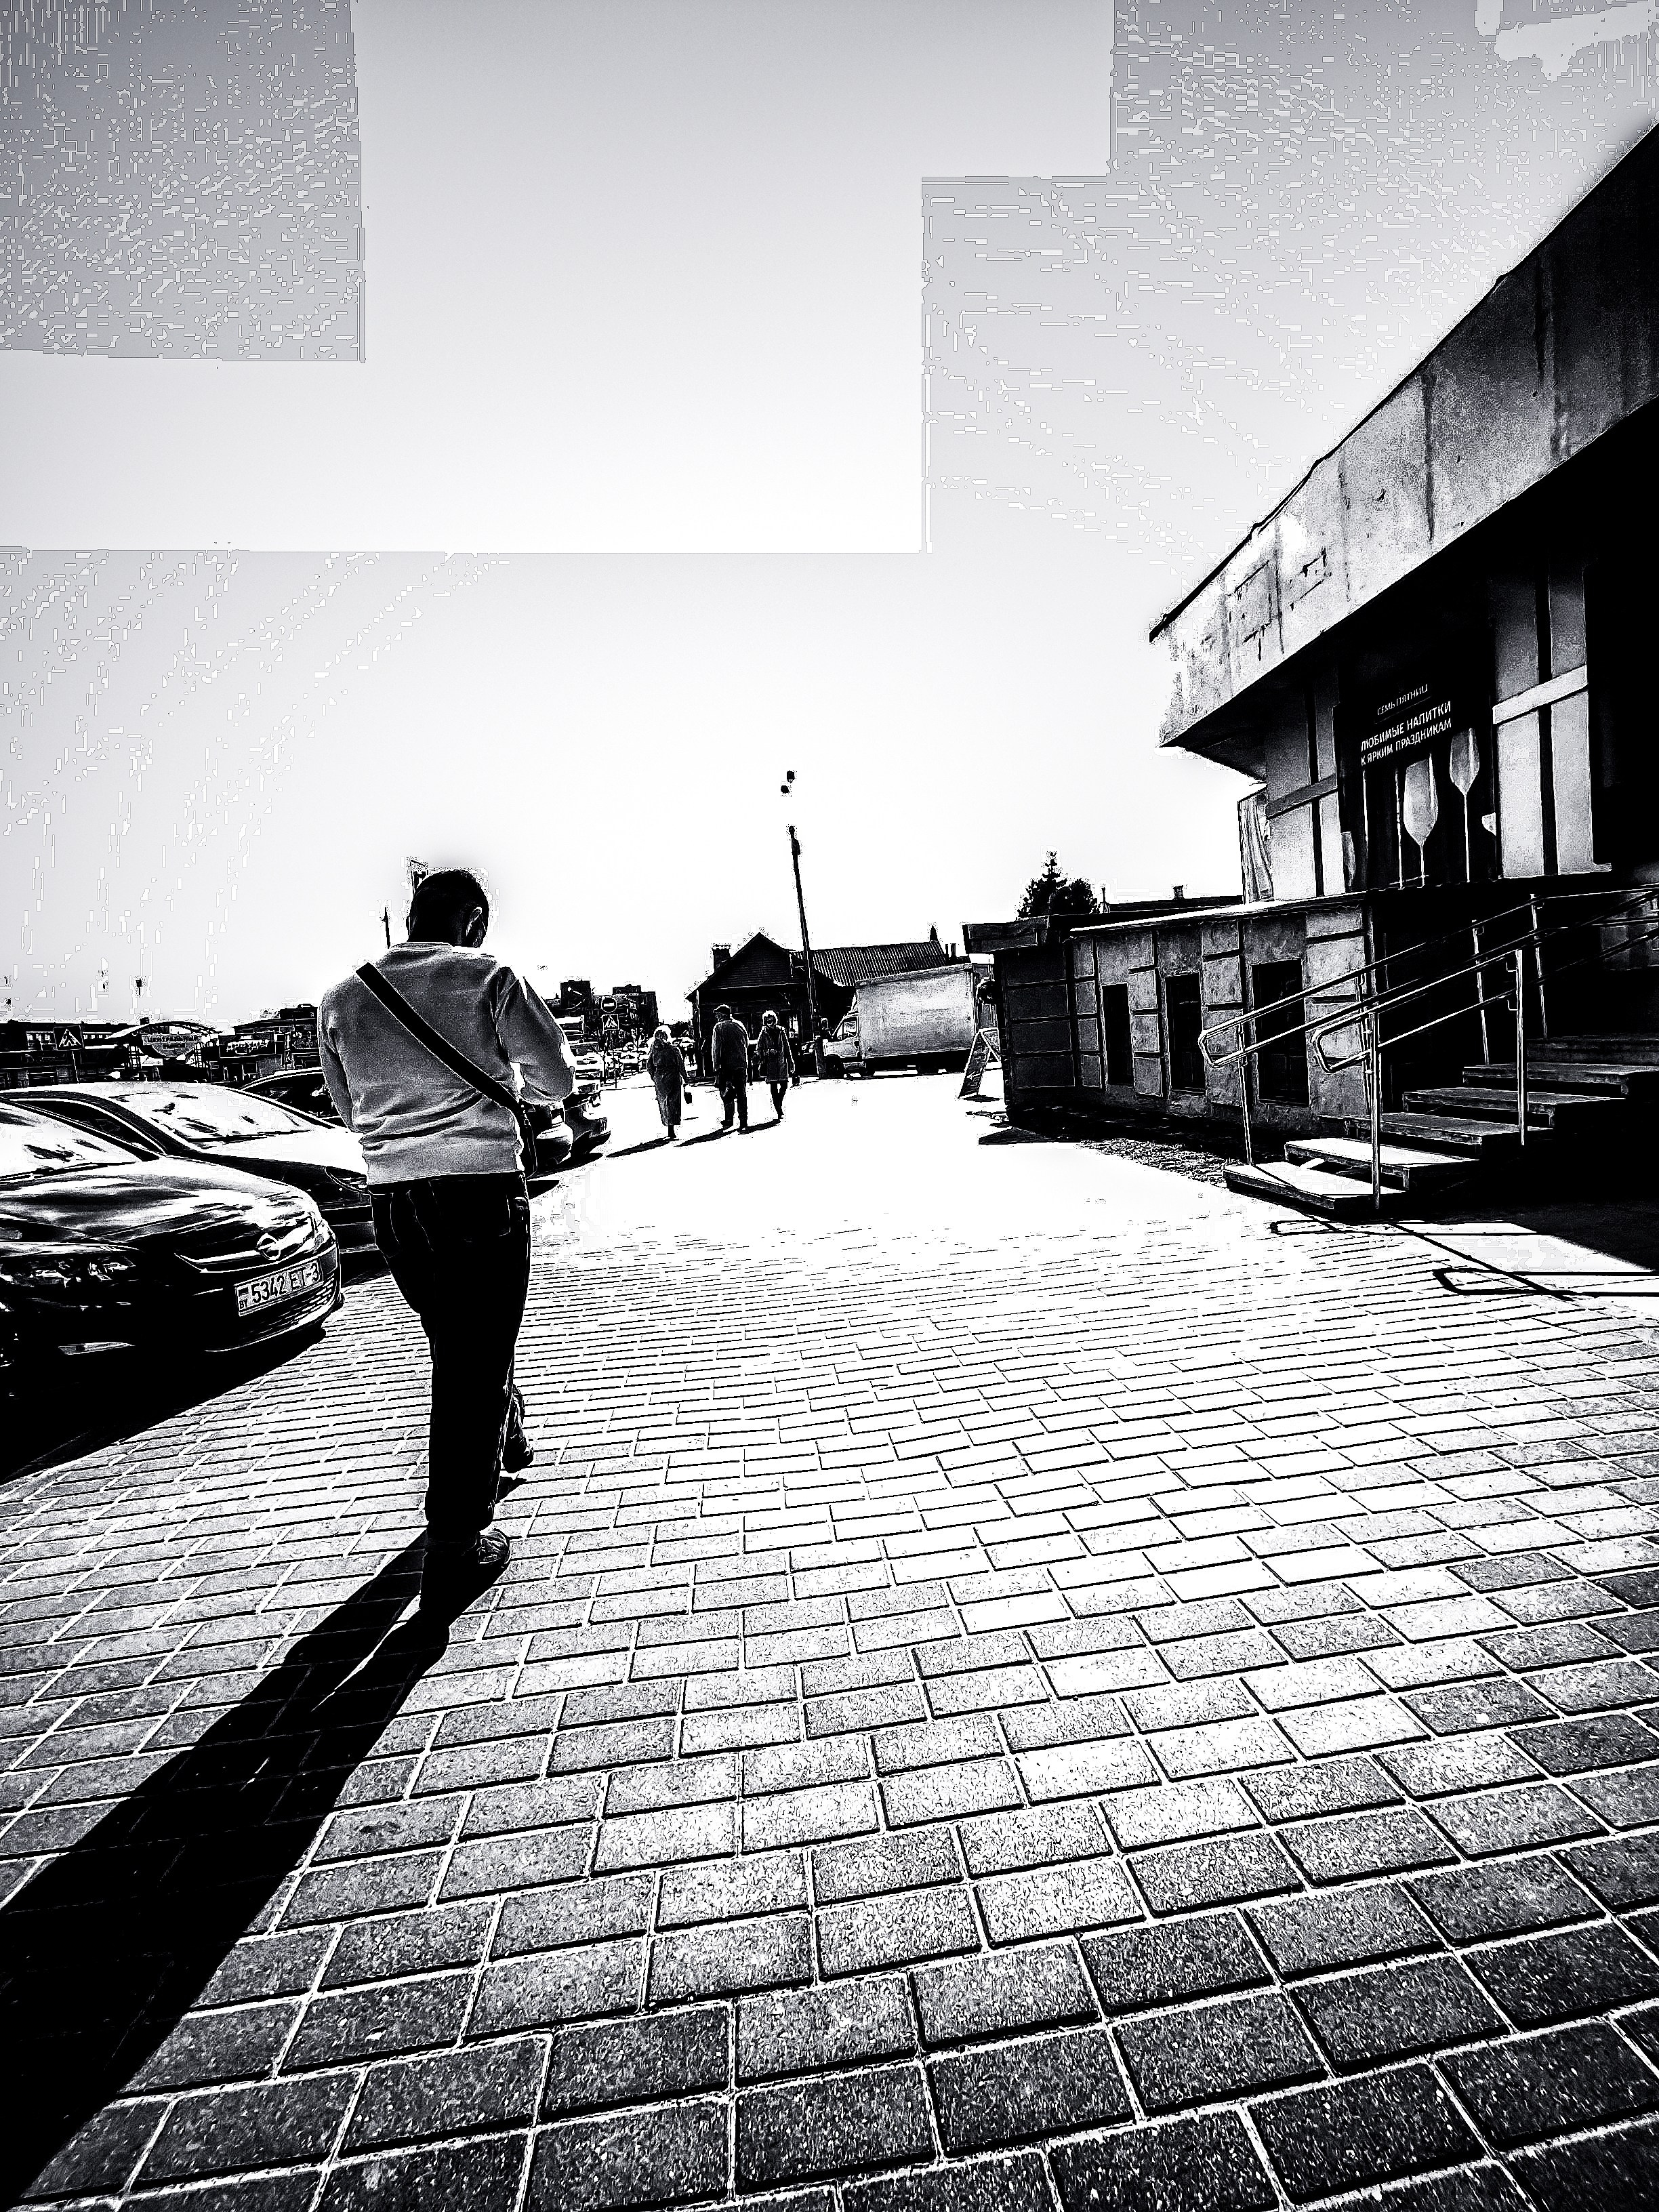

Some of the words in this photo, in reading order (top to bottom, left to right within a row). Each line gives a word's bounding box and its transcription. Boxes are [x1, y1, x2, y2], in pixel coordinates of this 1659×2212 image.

[1377, 701, 1395, 716] СЕМЬ
[1361, 722, 1405, 752] ЛЮБИМЫЕ
[1406, 700, 1451, 731] НАПИТКИ
[1361, 755, 1366, 766] К
[1367, 743, 1393, 763] ЯРКИМ
[1395, 718, 1452, 752] ПРАЗДНИКАМ
[251, 1275, 287, 1304] 5342
[239, 1299, 249, 1310] BY
